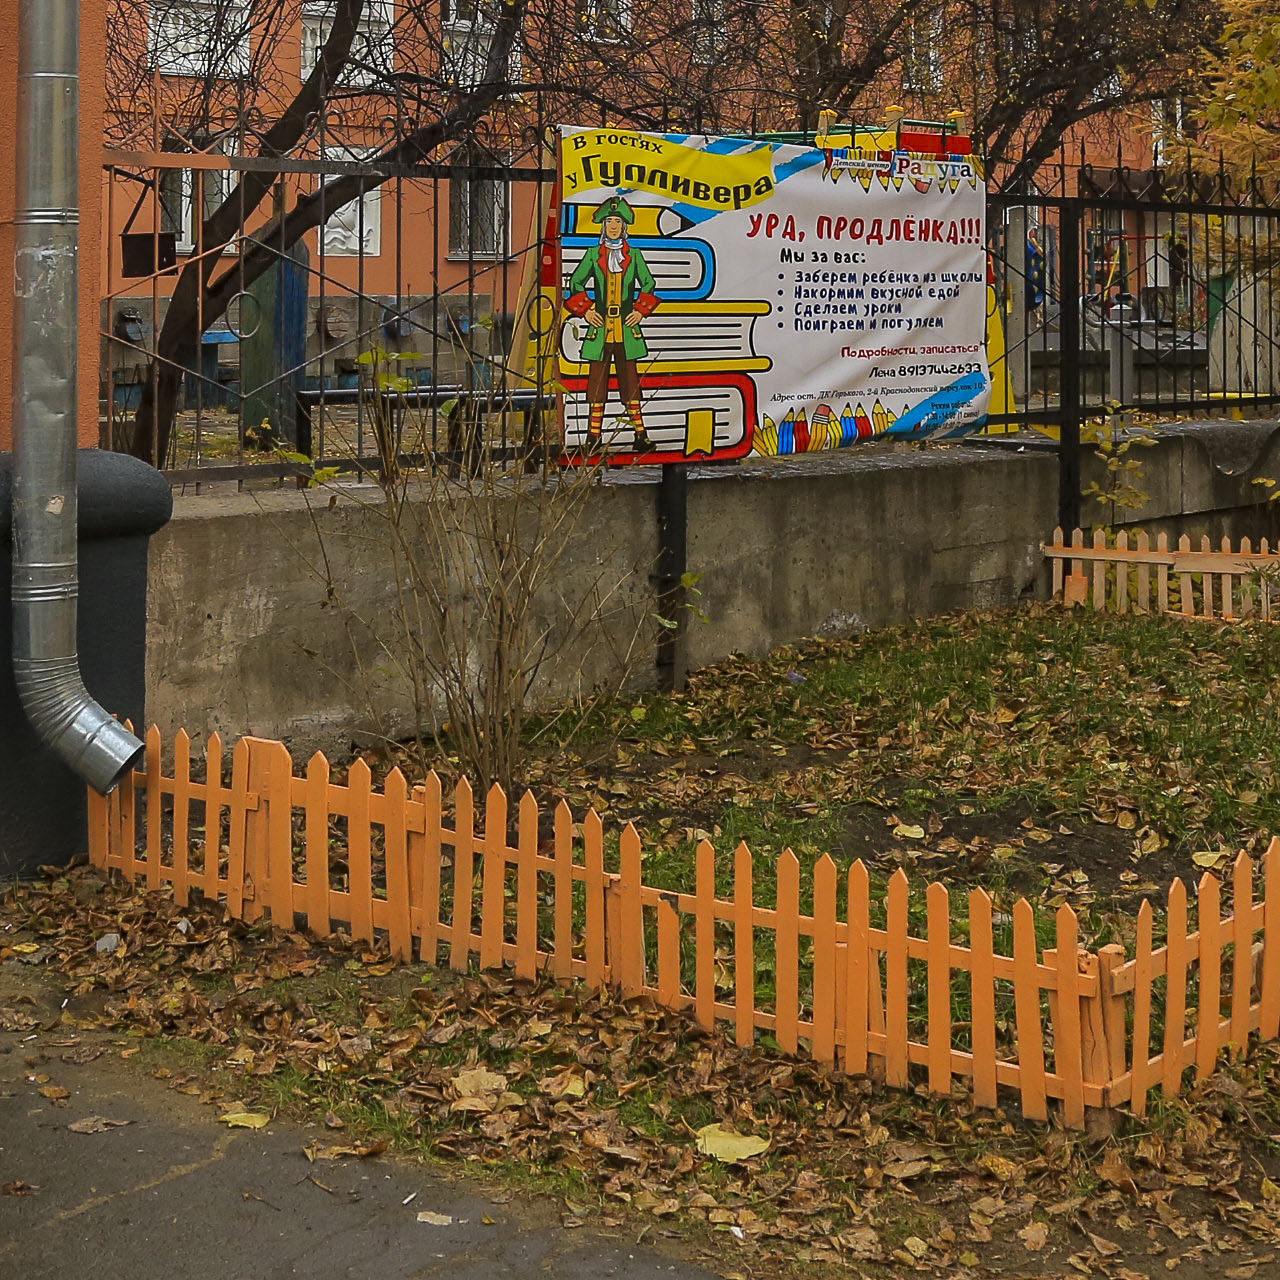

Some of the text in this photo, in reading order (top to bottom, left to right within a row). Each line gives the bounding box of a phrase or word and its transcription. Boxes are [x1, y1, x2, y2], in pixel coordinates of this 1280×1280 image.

[572, 134, 664, 154] В гостях
[833, 158, 972, 181] Детский центр Радуга
[565, 153, 774, 210] у Гулливера
[746, 213, 982, 245] УРА, ПРОДЛЁНКА!!!
[780, 248, 867, 264] Мы за вас:
[794, 270, 983, 285] Заберем ребёнка из школы
[794, 285, 960, 300] Накормим вкусной едой
[794, 302, 902, 317] Сделаем уроки
[794, 318, 944, 334] Поиграем и погуляем
[841, 344, 979, 359] Подробности, записаться
[869, 363, 982, 378] Лена 89137442633
[770, 393, 795, 403] Адрес
[867, 387, 879, 396] 2-й
[880, 384, 938, 397] Краснодонский
